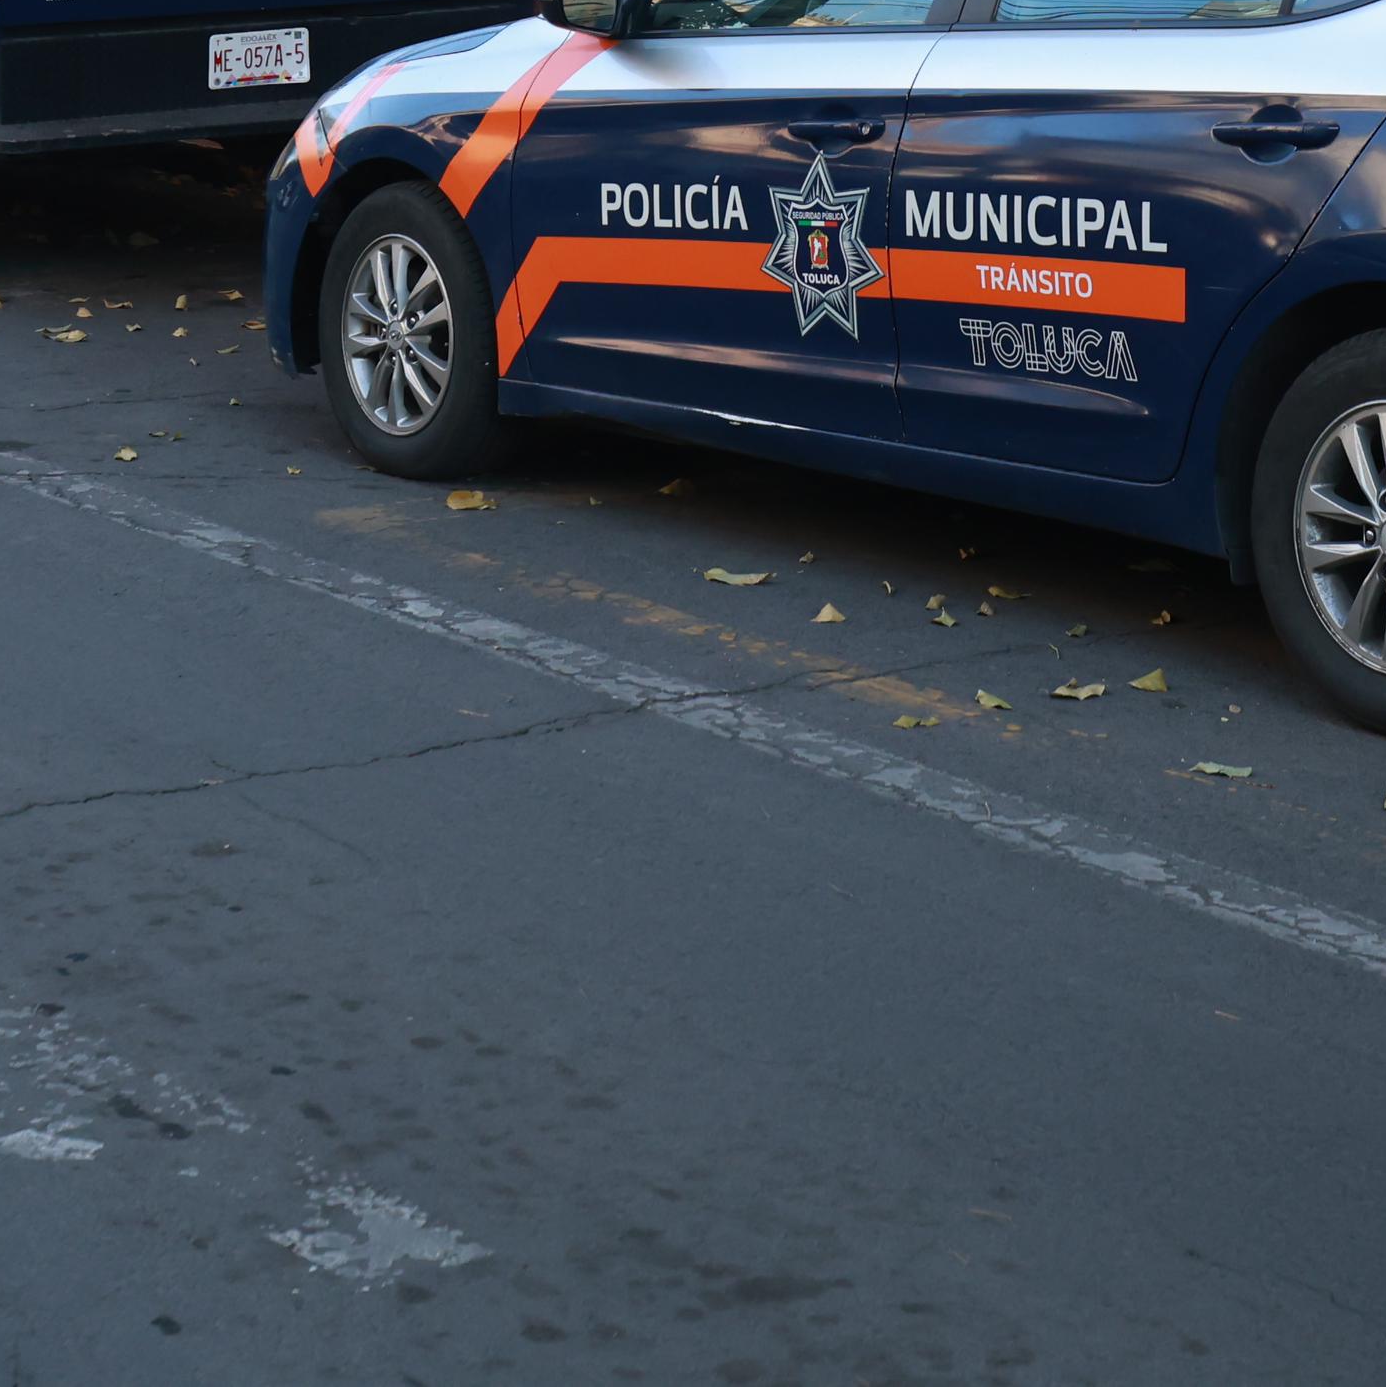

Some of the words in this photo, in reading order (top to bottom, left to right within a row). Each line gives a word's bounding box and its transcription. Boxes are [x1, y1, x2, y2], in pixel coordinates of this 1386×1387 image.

[213, 43, 305, 73] ME-057A-5
[600, 174, 749, 231] POLICÍA
[905, 189, 1168, 253] MUNICIPAL
[792, 211, 822, 220] SEGURIDAD
[802, 273, 840, 285] TOLUCA
[975, 263, 1093, 299] TRÁNSITO
[959, 317, 1138, 383] TOLUCA
